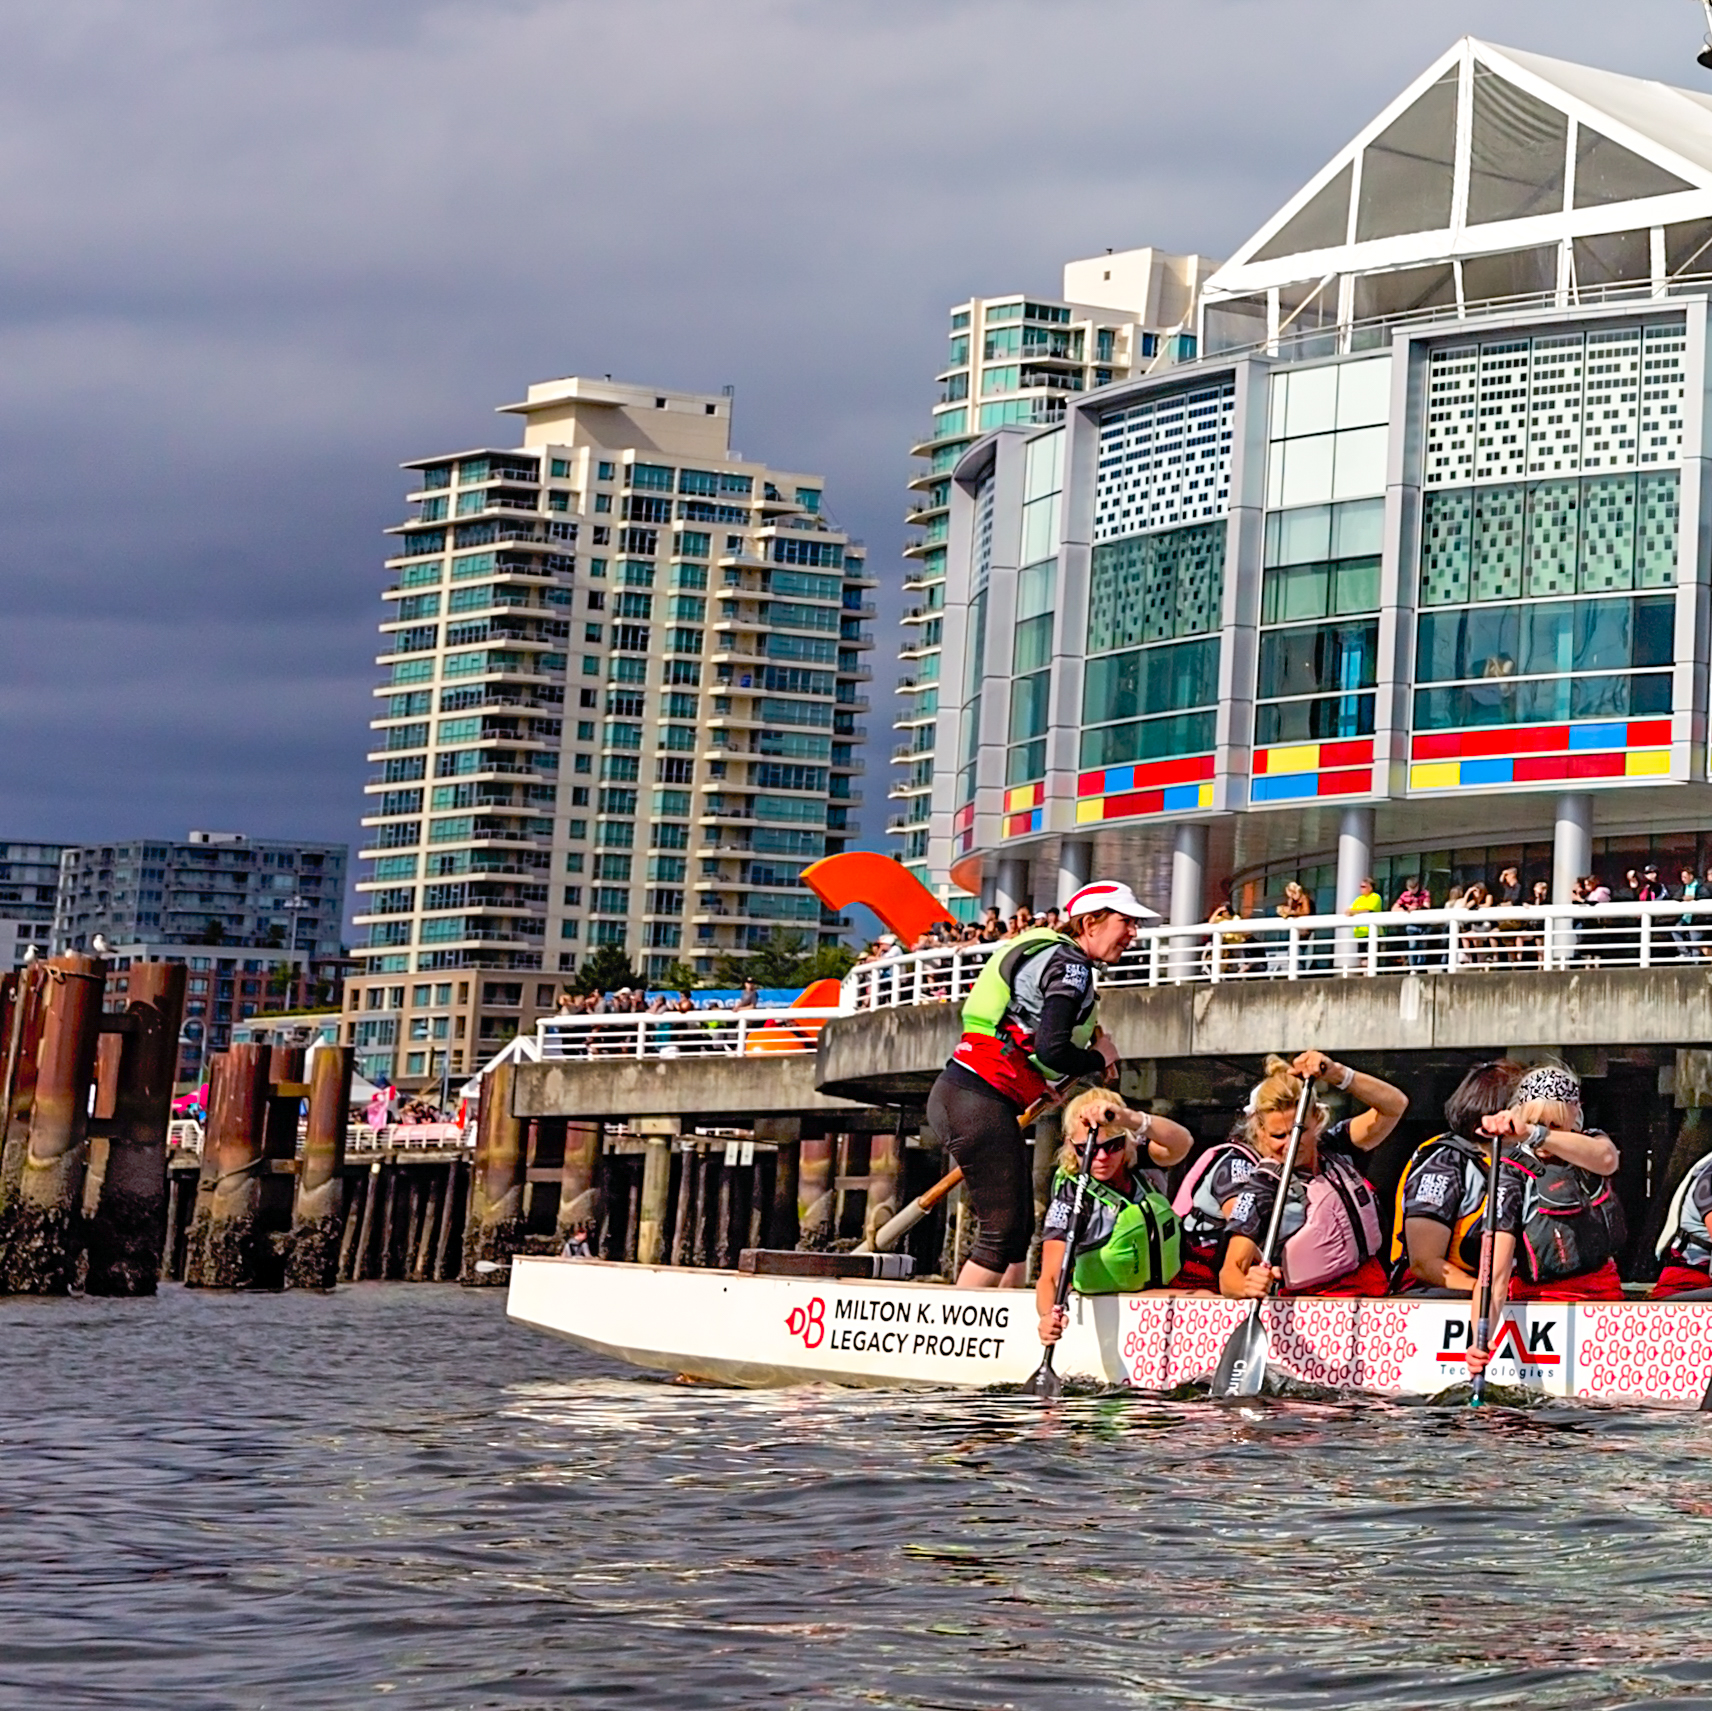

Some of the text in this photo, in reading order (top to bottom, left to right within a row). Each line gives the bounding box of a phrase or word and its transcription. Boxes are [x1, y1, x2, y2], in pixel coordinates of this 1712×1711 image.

[1421, 1173, 1450, 1188] FALSE
[1418, 1184, 1448, 1199] CREEK
[834, 1299, 1009, 1328] MILTON K. WONG
[830, 1329, 1005, 1359] LEGACY PROJECT
[1440, 1364, 1554, 1379] Tecologies
